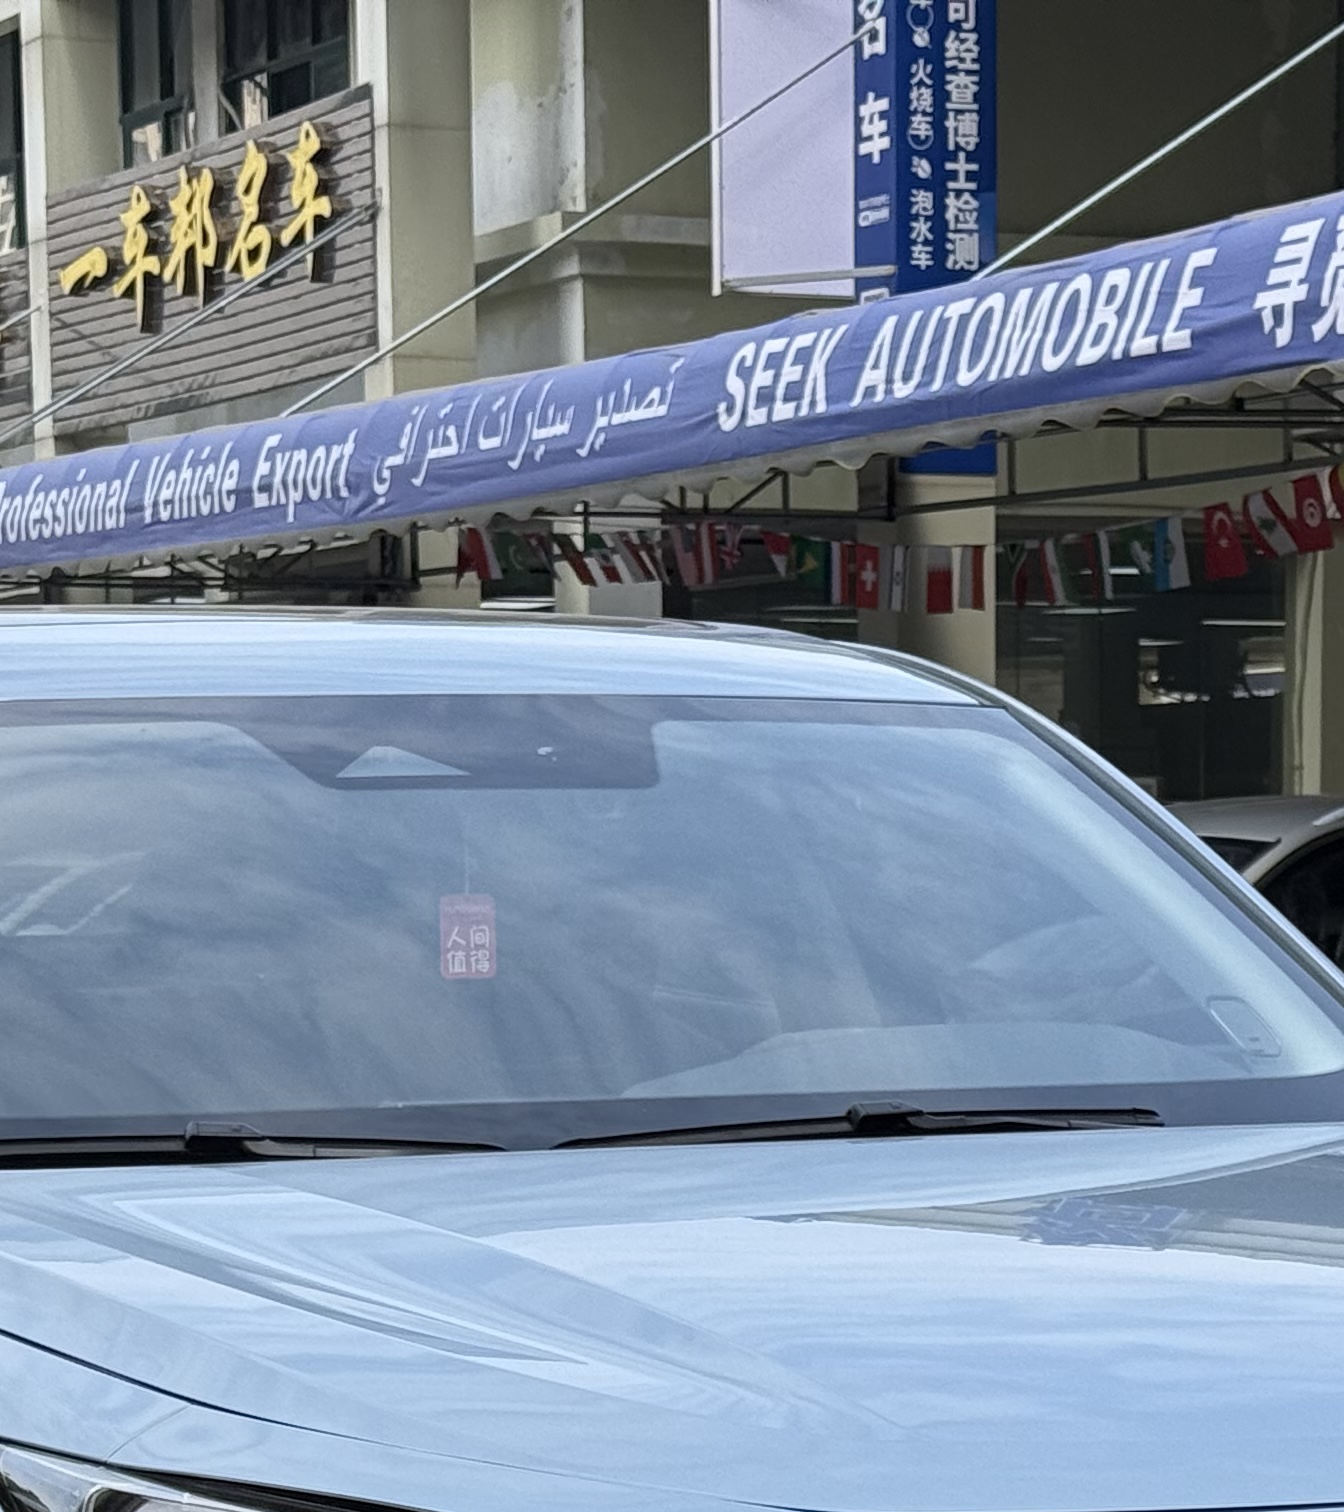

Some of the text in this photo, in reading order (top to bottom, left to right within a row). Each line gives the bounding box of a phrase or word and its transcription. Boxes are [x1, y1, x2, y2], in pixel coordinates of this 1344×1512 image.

[909, 58, 934, 141] 火烧车
[909, 189, 934, 270] 泡水车
[717, 247, 1217, 432] SEEK AUTOMOBILE
[372, 358, 678, 505] تصدير سيارات احترافي
[143, 441, 237, 524] Vehicle
[252, 429, 357, 522] Export
[447, 925, 490, 949] 人间
[447, 950, 490, 974] 值得
